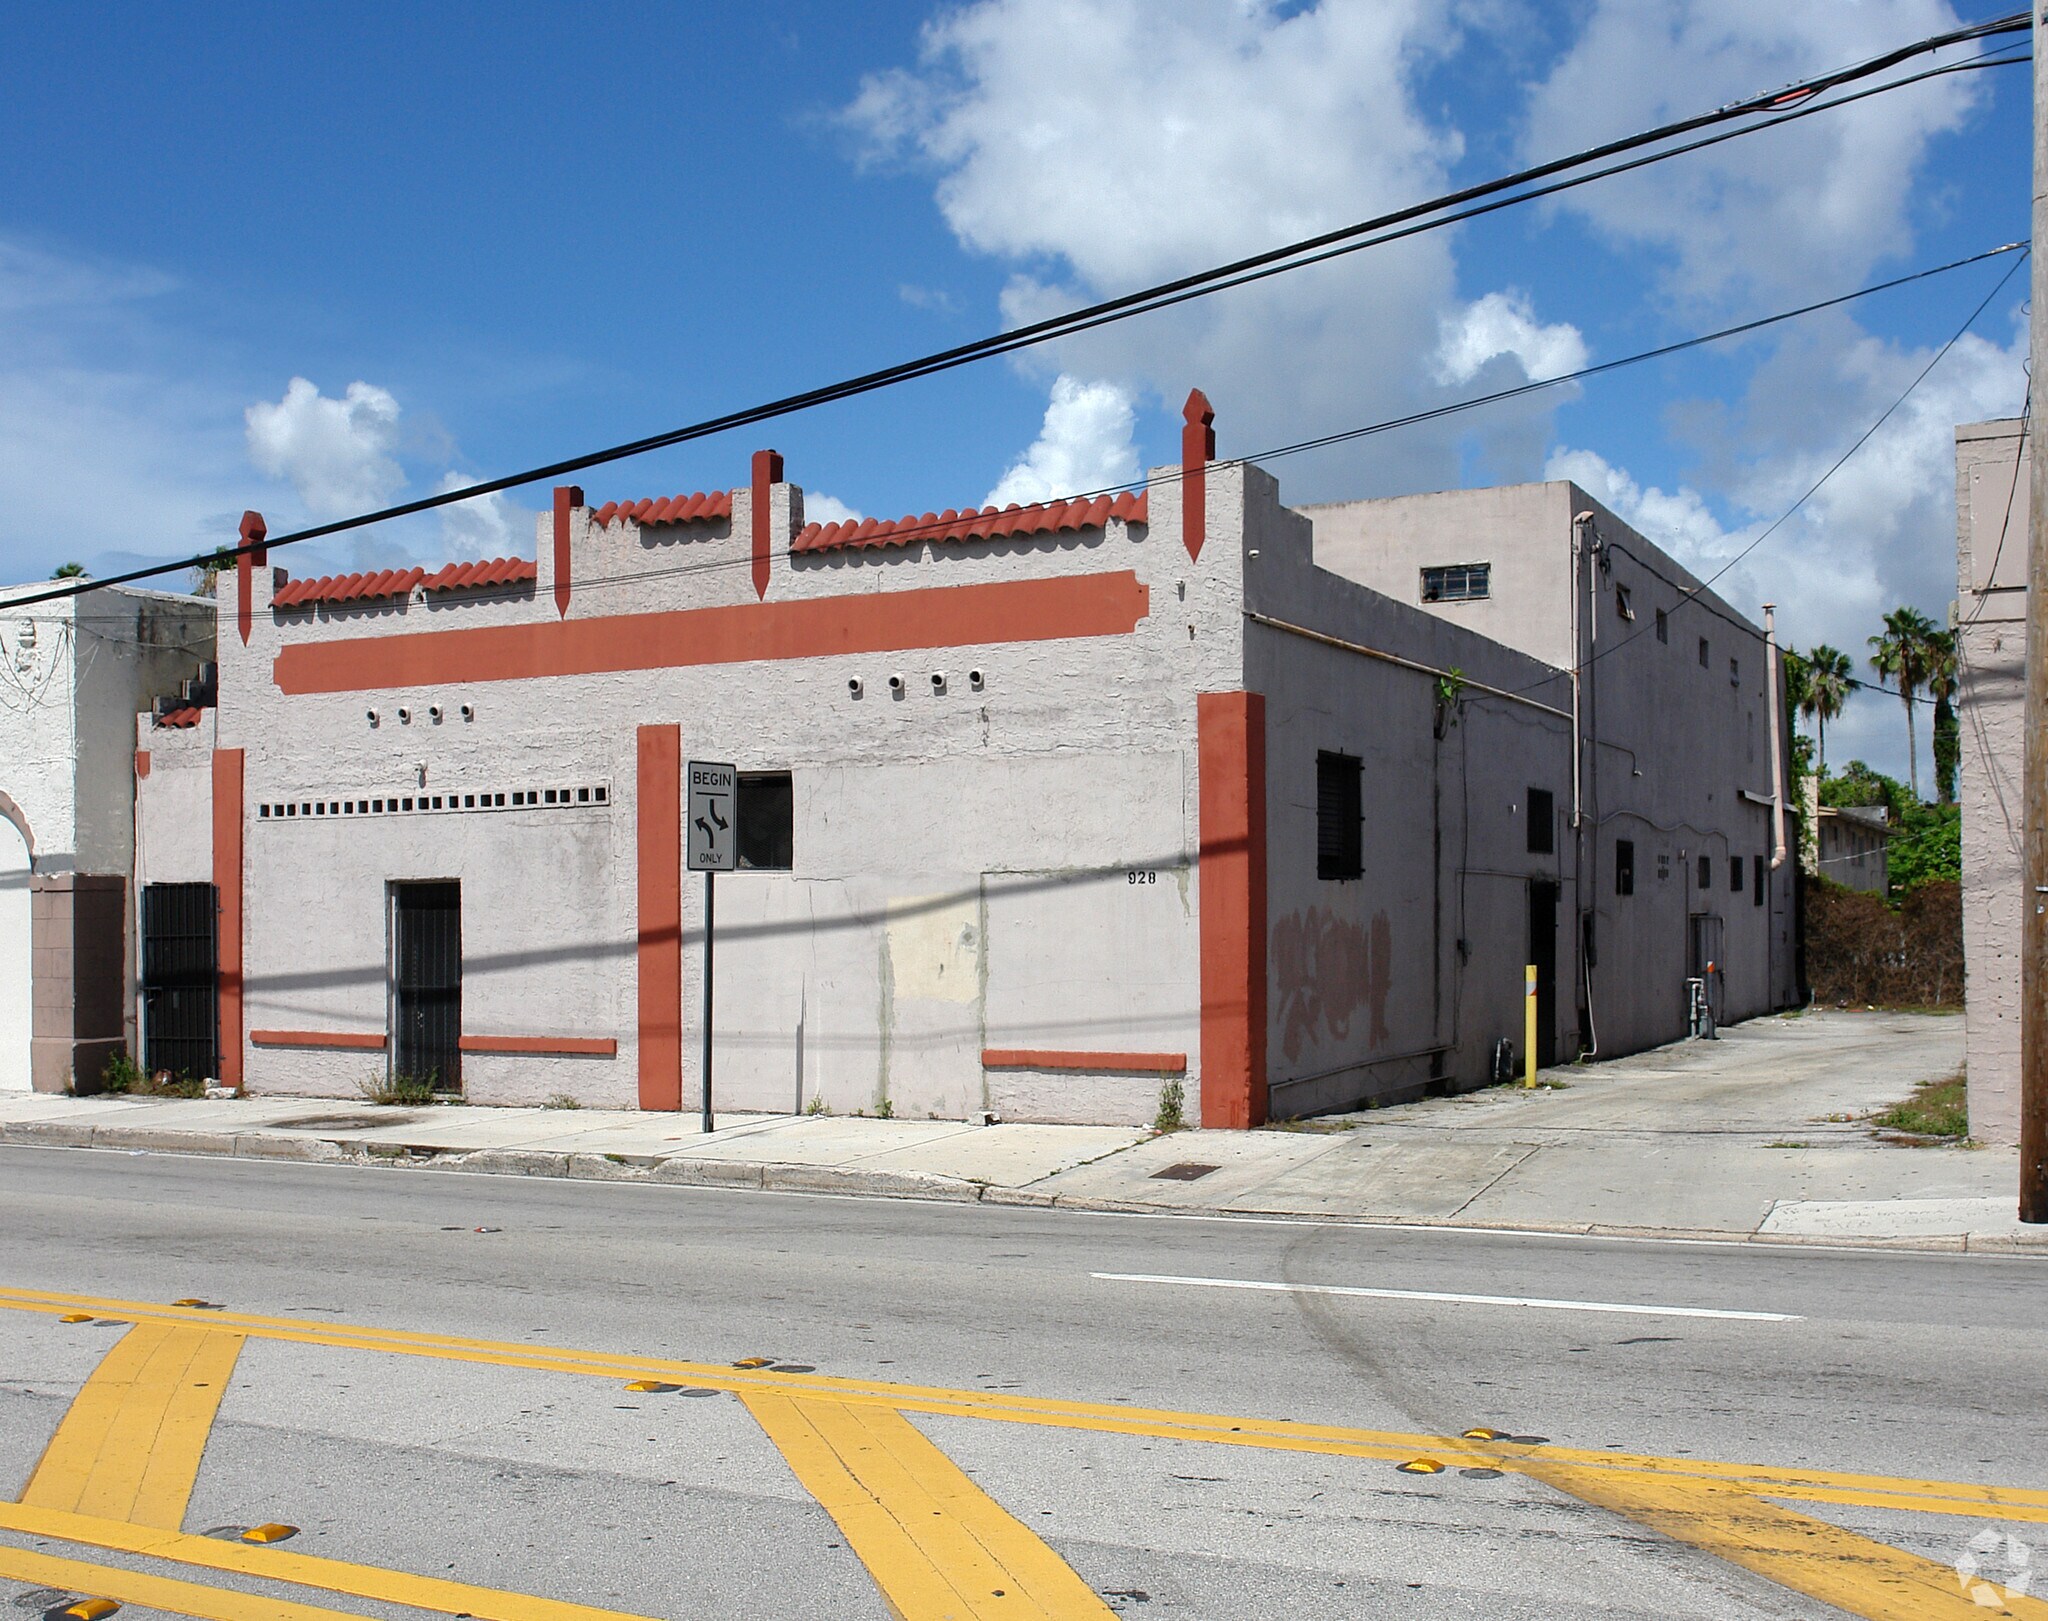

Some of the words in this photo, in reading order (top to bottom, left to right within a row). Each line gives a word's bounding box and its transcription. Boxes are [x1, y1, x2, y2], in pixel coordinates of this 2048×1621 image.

[693, 771, 731, 787] BEGIN
[699, 853, 723, 864] ONLY
[1128, 871, 1156, 884] 928
